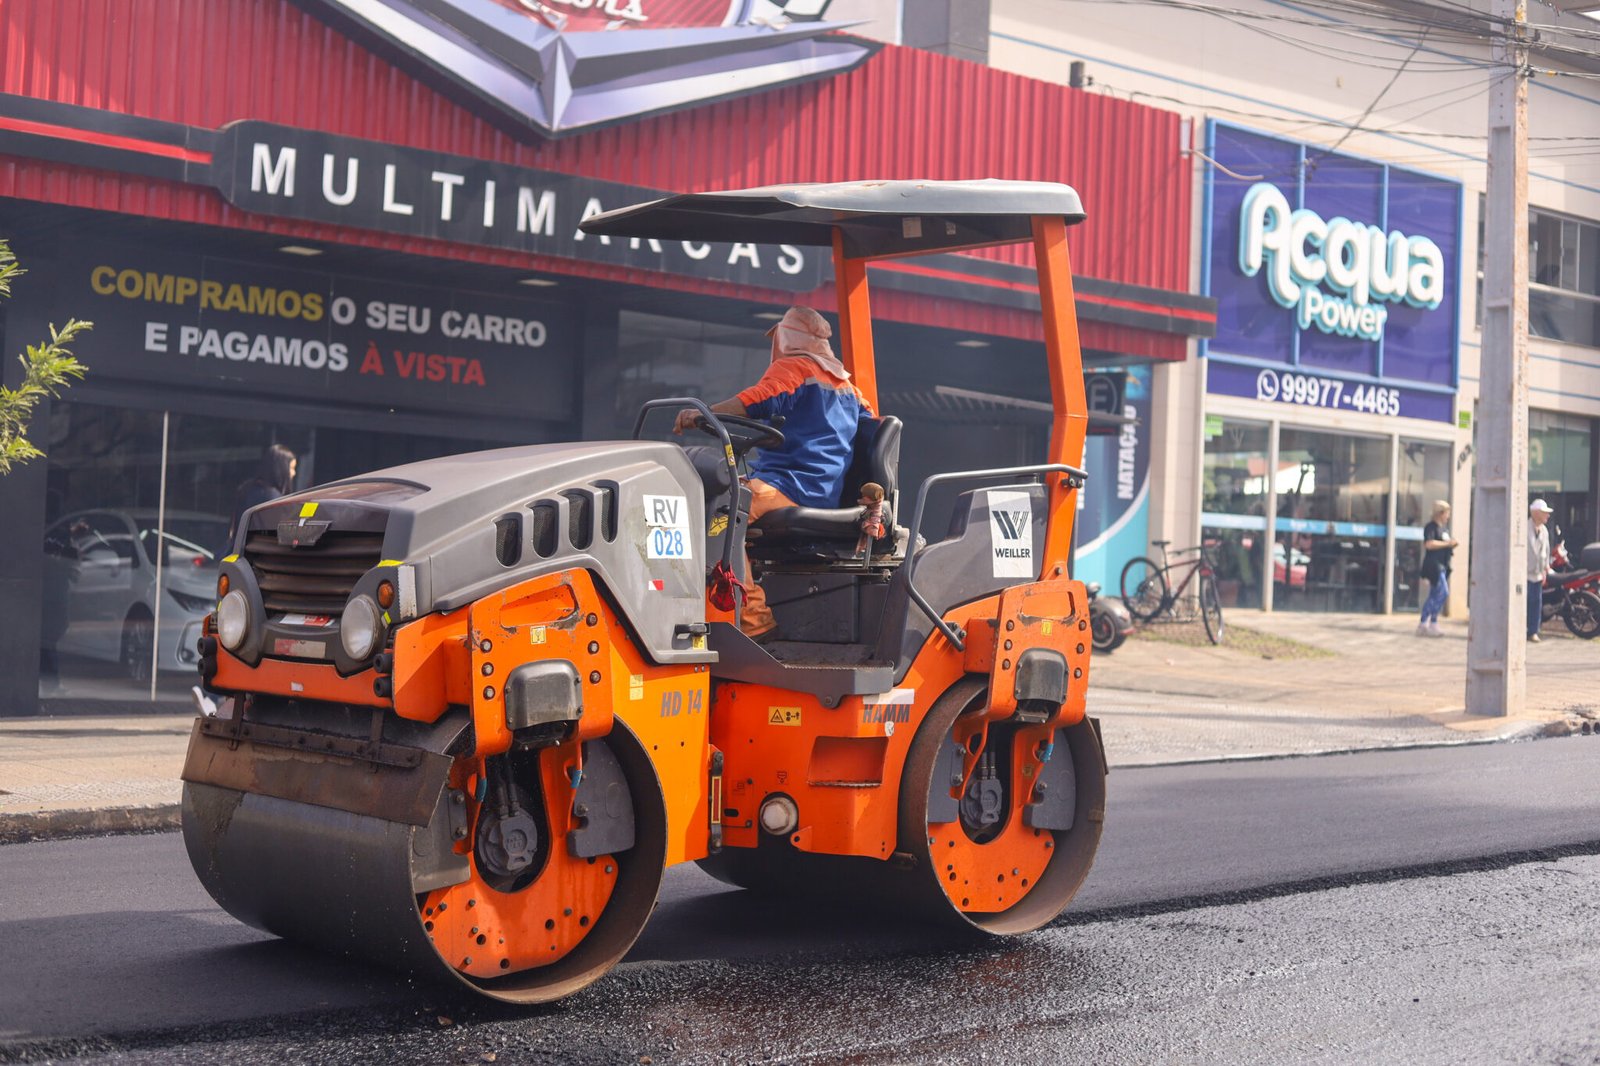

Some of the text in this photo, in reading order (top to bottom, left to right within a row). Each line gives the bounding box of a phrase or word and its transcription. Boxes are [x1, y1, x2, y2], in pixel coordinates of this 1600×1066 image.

[1240, 183, 1445, 310] Acqua
[91, 266, 547, 347] COMPRAMOS O SEU CARRO
[1299, 287, 1387, 341] Power
[145, 321, 486, 386] E PAGAMOS À VISTA
[1281, 373, 1400, 416] 99977-4465
[652, 498, 678, 524] RV
[654, 529, 684, 556] 028
[995, 548, 1031, 558] WEILLER
[660, 688, 702, 717] HD 14
[863, 703, 911, 723] HAMM
